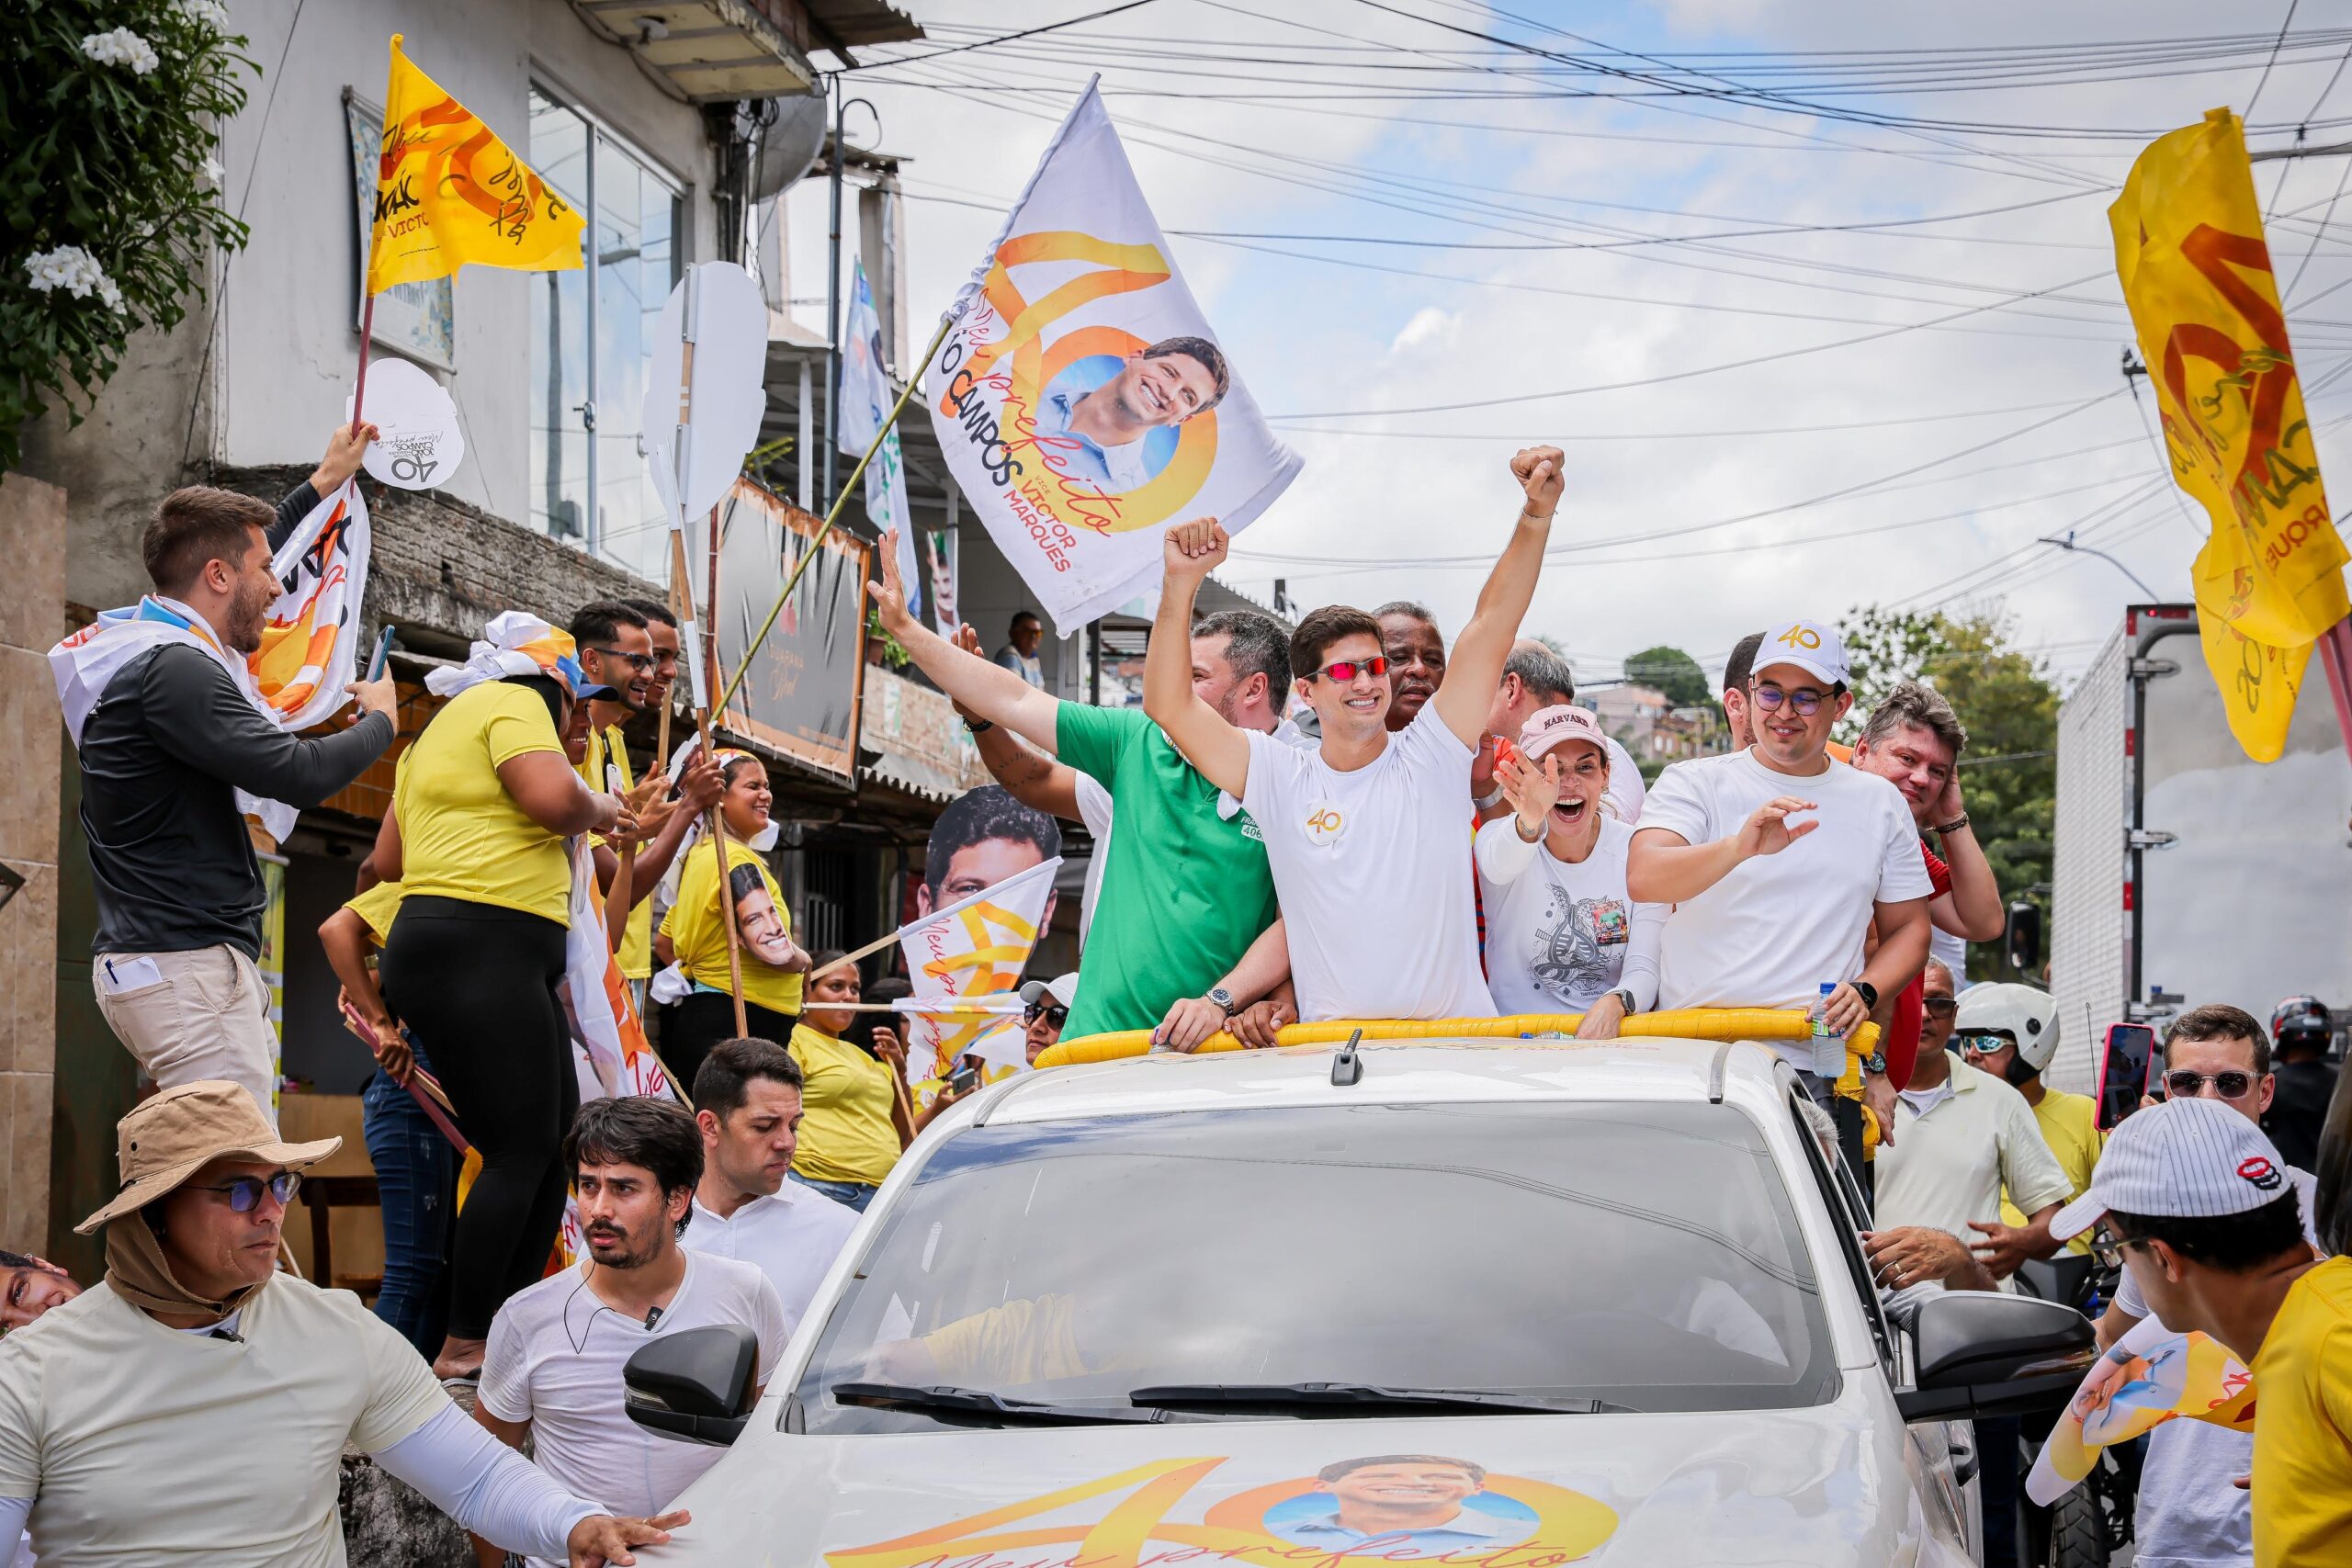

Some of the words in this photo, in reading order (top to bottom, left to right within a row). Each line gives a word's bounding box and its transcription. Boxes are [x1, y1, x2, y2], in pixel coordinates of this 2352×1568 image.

[948, 368, 1024, 488] CAMPOS
[395, 441, 434, 452] CAMPOS
[968, 372, 1123, 538] prefeito
[390, 457, 439, 483] 40
[1020, 478, 1078, 550] VICTOR
[1003, 489, 1072, 574] MARQUES
[1778, 624, 1821, 649] 40
[1544, 713, 1589, 731] HARVARD
[1307, 808, 1342, 834] 40
